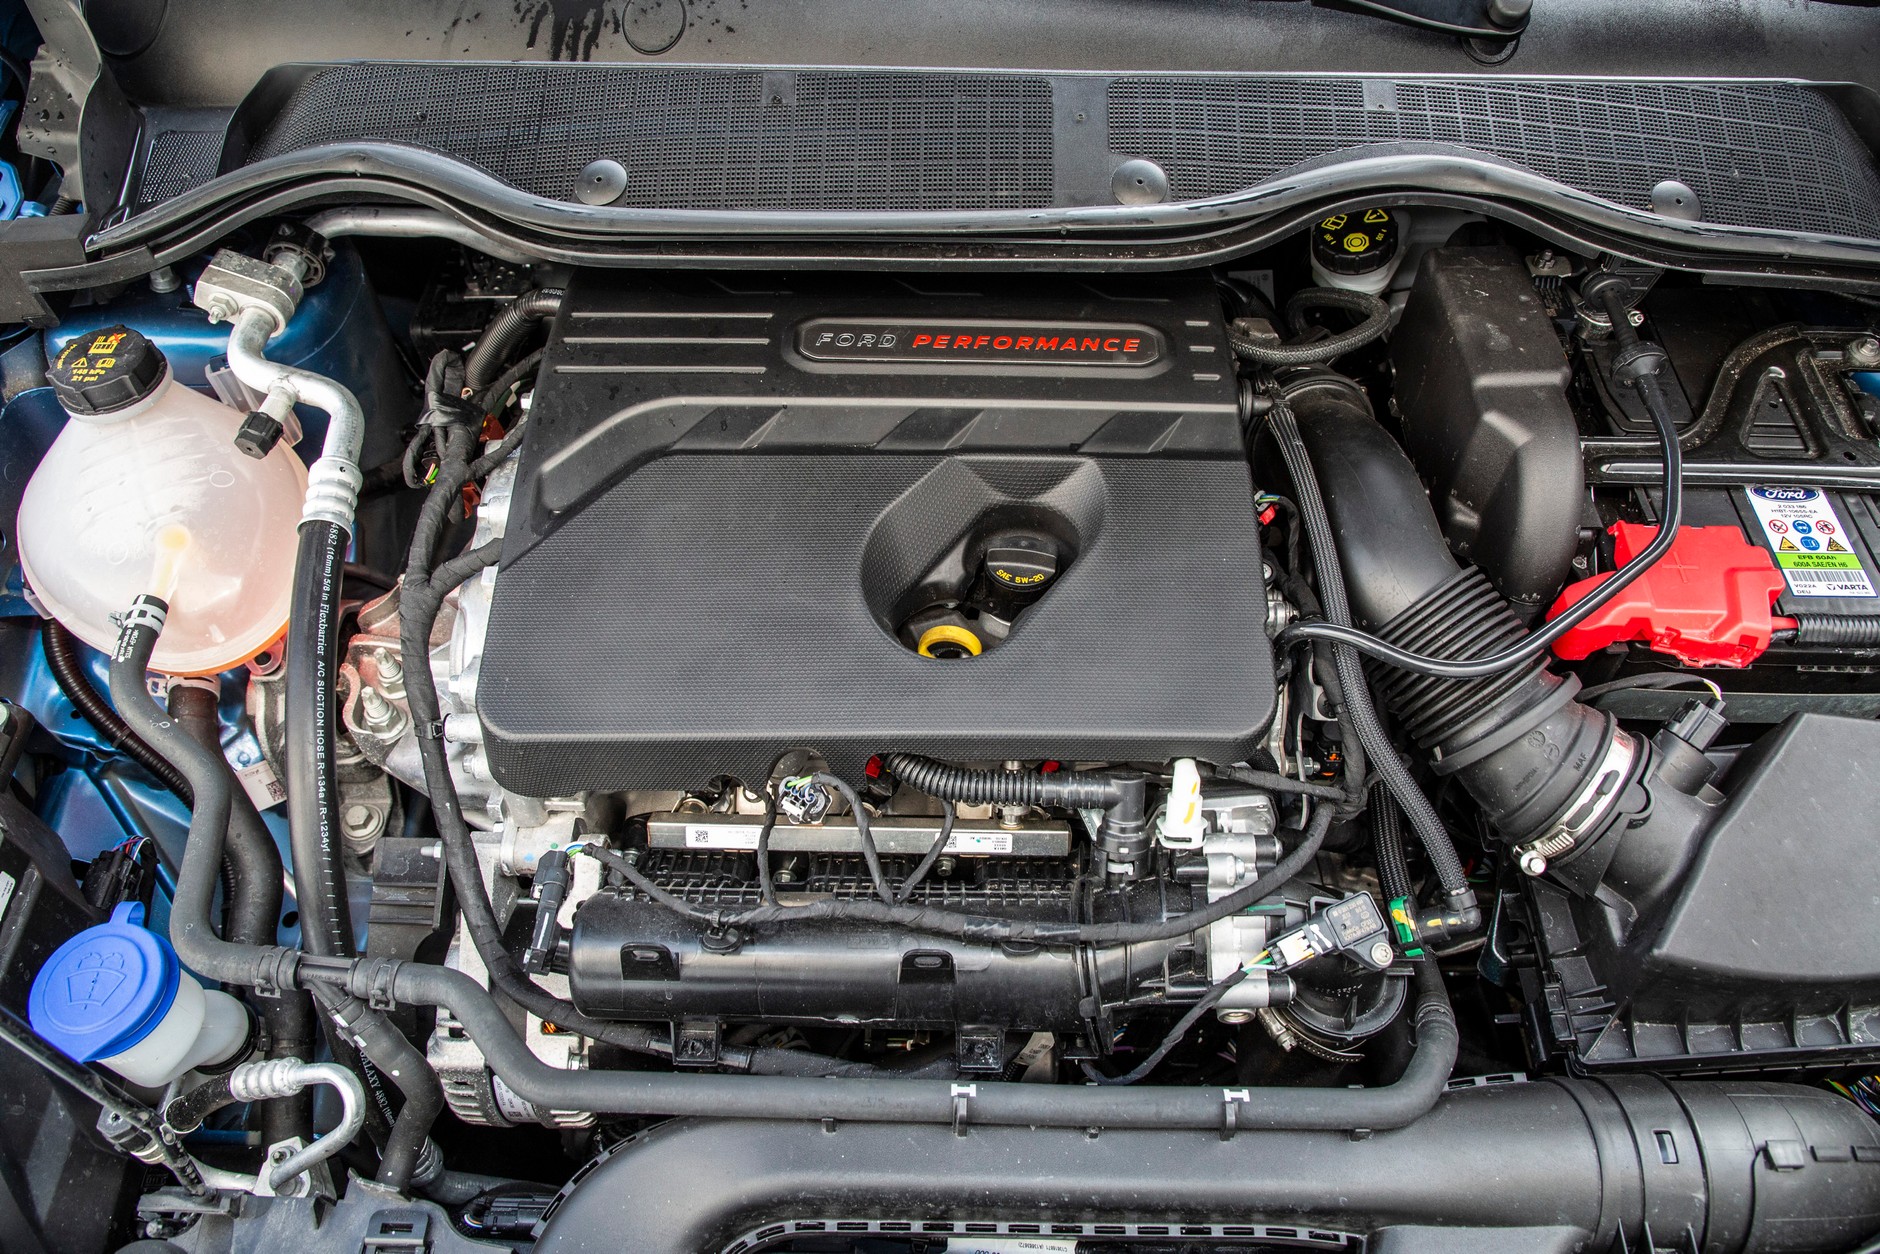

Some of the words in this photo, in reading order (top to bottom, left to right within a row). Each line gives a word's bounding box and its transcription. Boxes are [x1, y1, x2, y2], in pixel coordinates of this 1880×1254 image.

[816, 332, 897, 348] FORD
[912, 333, 1141, 352] PERFORMANCE
[1765, 488, 1807, 500] Ford
[328, 523, 339, 544] 4882
[325, 548, 335, 577] (16mm)
[323, 579, 332, 592] 5/8
[996, 569, 1012, 581] SAE
[1015, 573, 1045, 584] 5W-20
[322, 593, 330, 601] in
[317, 603, 330, 655] Flexbarrier
[317, 661, 326, 677] A/C
[316, 679, 325, 725] SUCTION
[317, 730, 325, 759] HOSE
[1573, 752, 1588, 772] MAF
[317, 763, 326, 798] R-134a
[319, 808, 331, 852] R-1234yf
[375, 1089, 388, 1107] 4882
[383, 1106, 396, 1127] (16mm)
